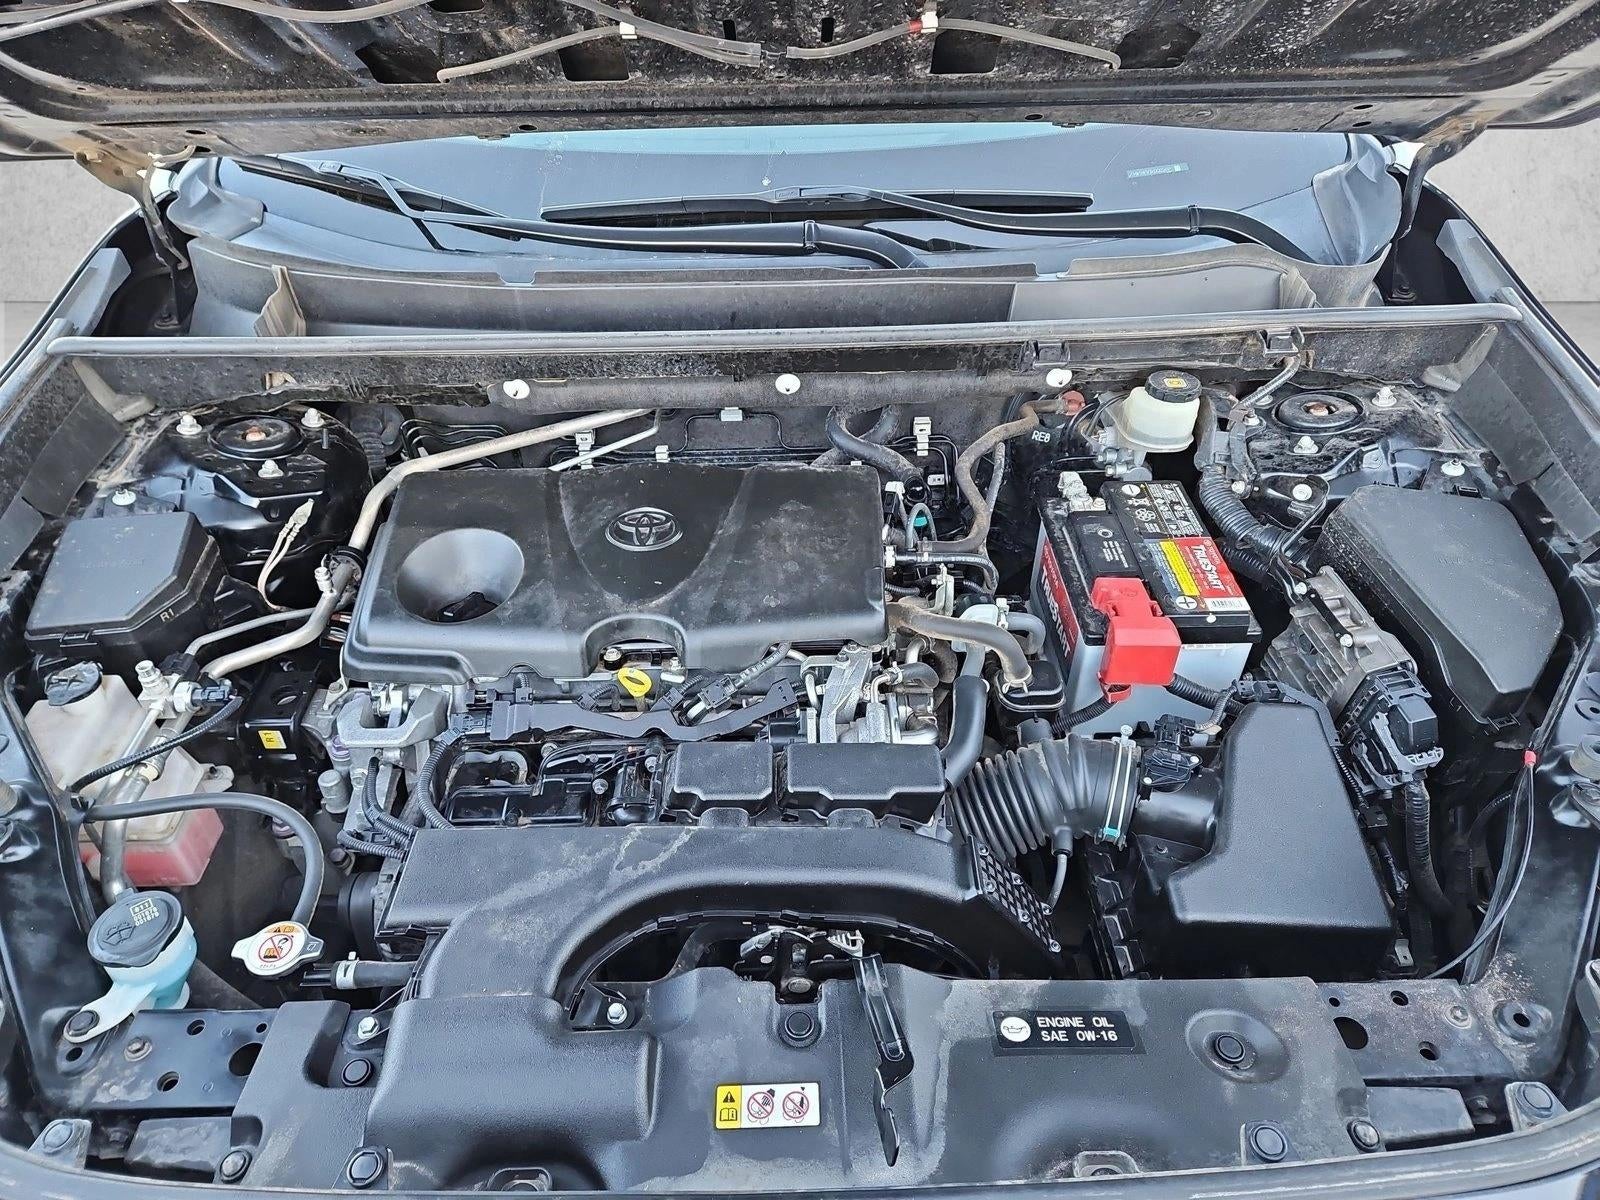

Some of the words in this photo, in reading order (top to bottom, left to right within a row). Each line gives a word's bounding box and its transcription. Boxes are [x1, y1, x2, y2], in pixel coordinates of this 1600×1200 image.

[160, 608, 174, 622] R1
[1036, 1016, 1086, 1028] ENGINE
[1092, 1016, 1115, 1028] OIL
[1041, 1030, 1069, 1042] SAE
